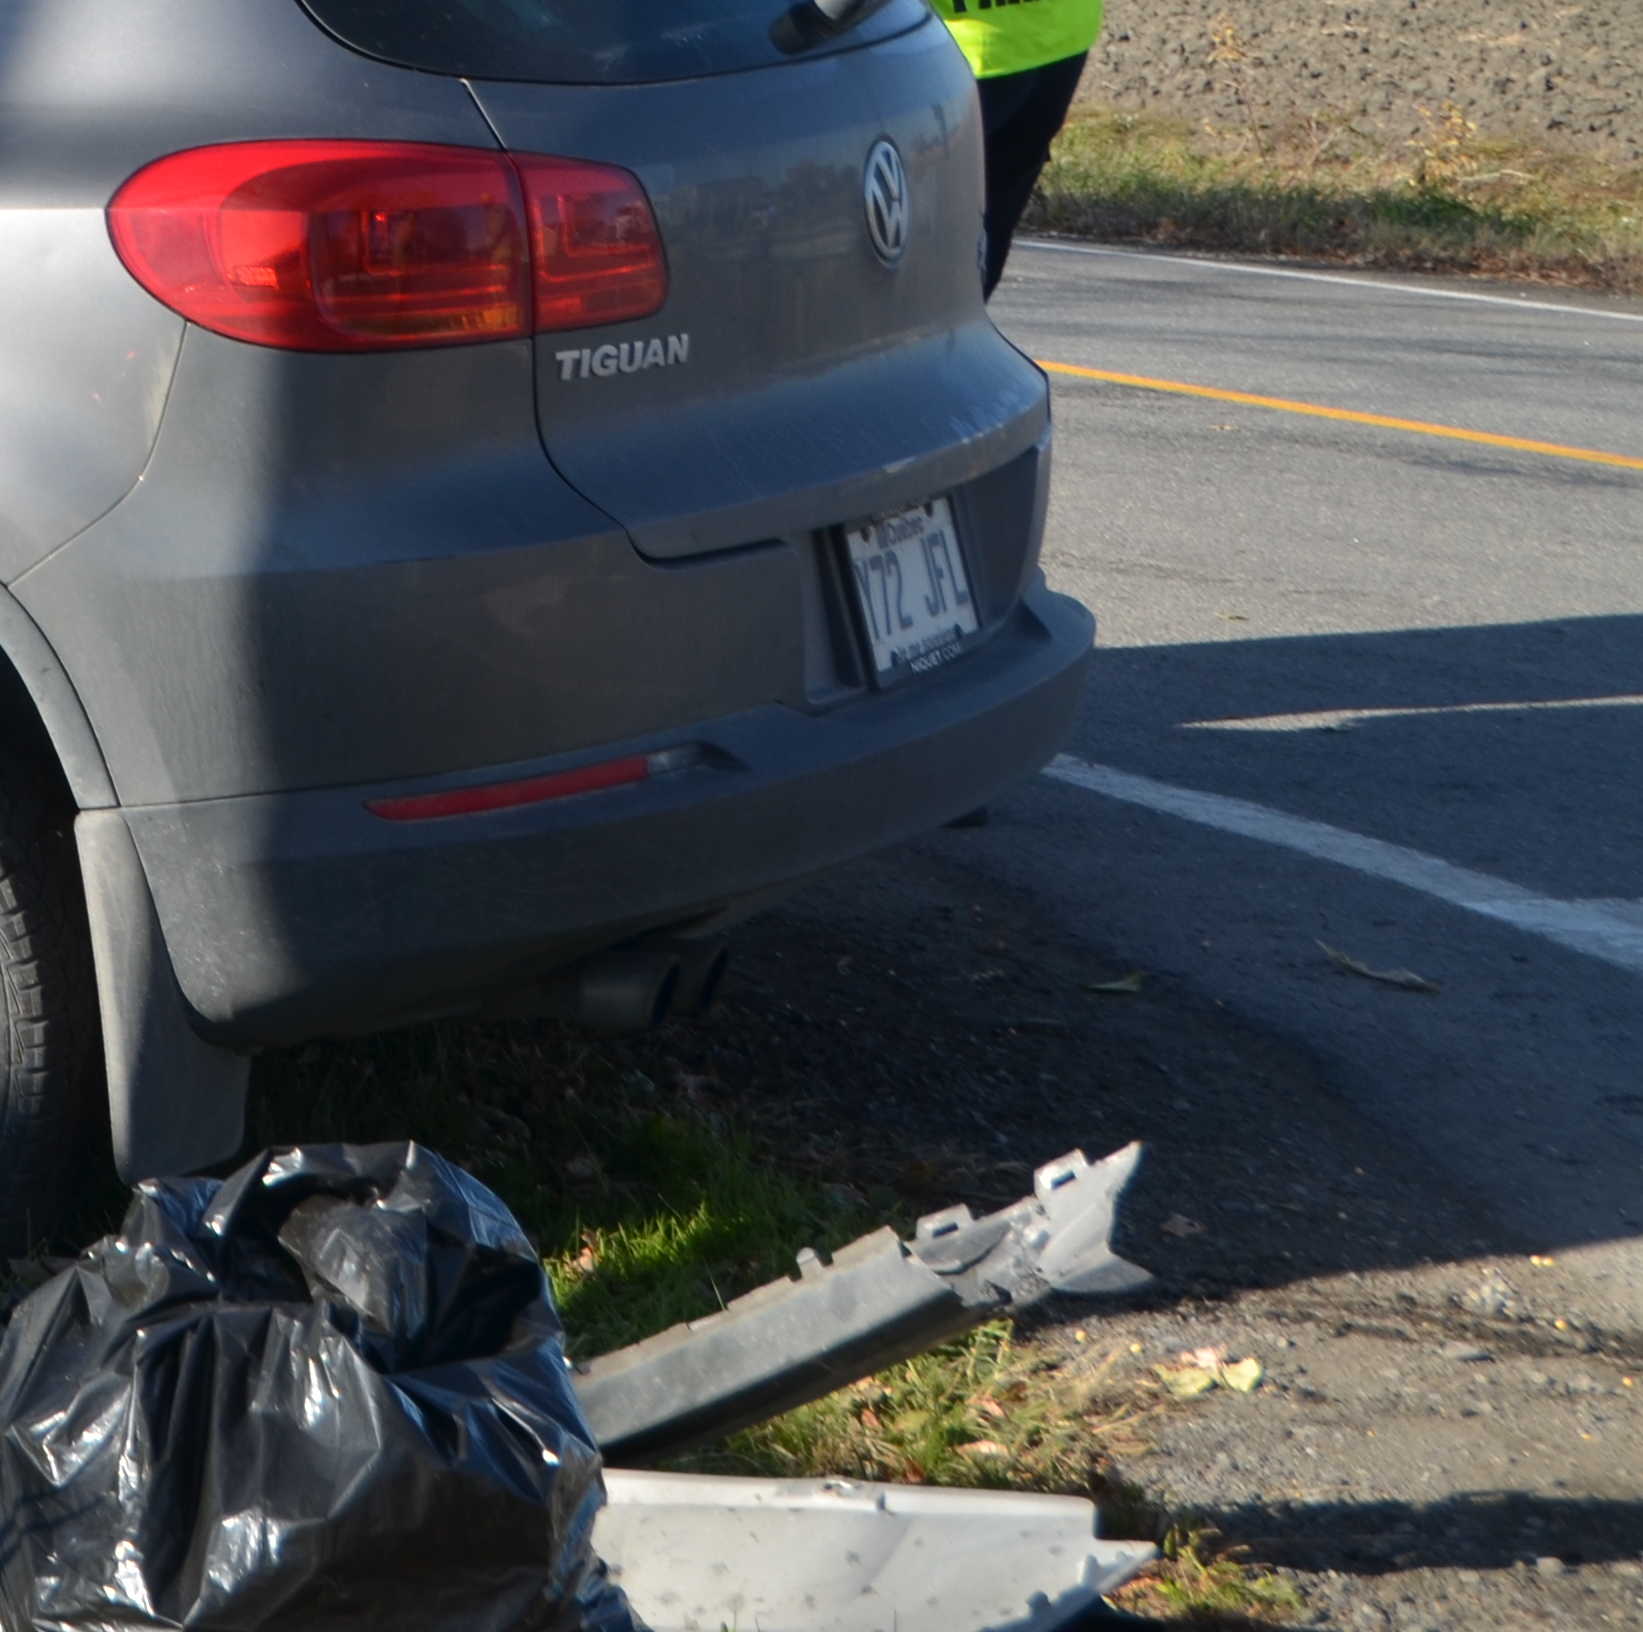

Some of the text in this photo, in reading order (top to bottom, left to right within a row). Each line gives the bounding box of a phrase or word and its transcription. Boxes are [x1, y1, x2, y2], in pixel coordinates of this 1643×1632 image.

[555, 333, 689, 381] TIGUAN
[854, 529, 969, 641] Y72 JFL
